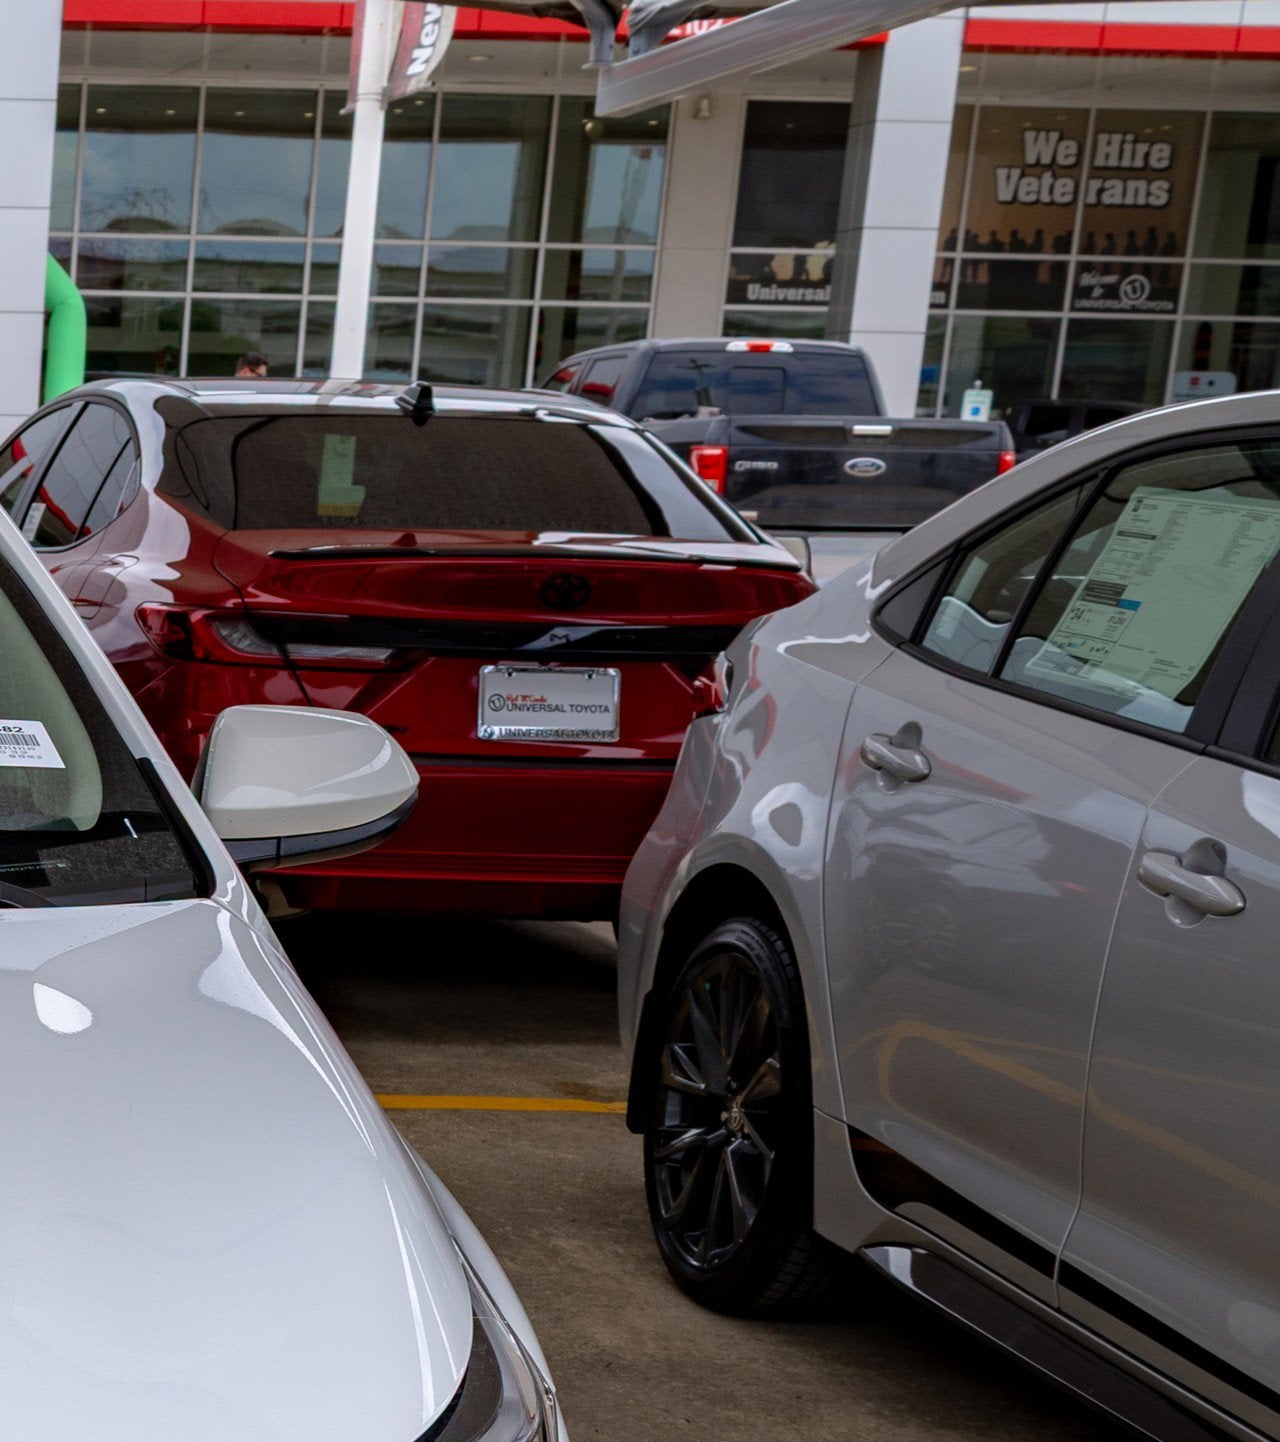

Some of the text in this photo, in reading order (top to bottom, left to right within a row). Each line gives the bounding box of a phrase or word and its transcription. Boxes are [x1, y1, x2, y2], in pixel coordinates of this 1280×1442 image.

[1024, 131, 1173, 169] We Hire
[746, 284, 831, 301] Universal
[506, 703, 610, 714] UNIVERSAL TOYOTA
[500, 727, 614, 739] UNIVERSAL TOYOTA
